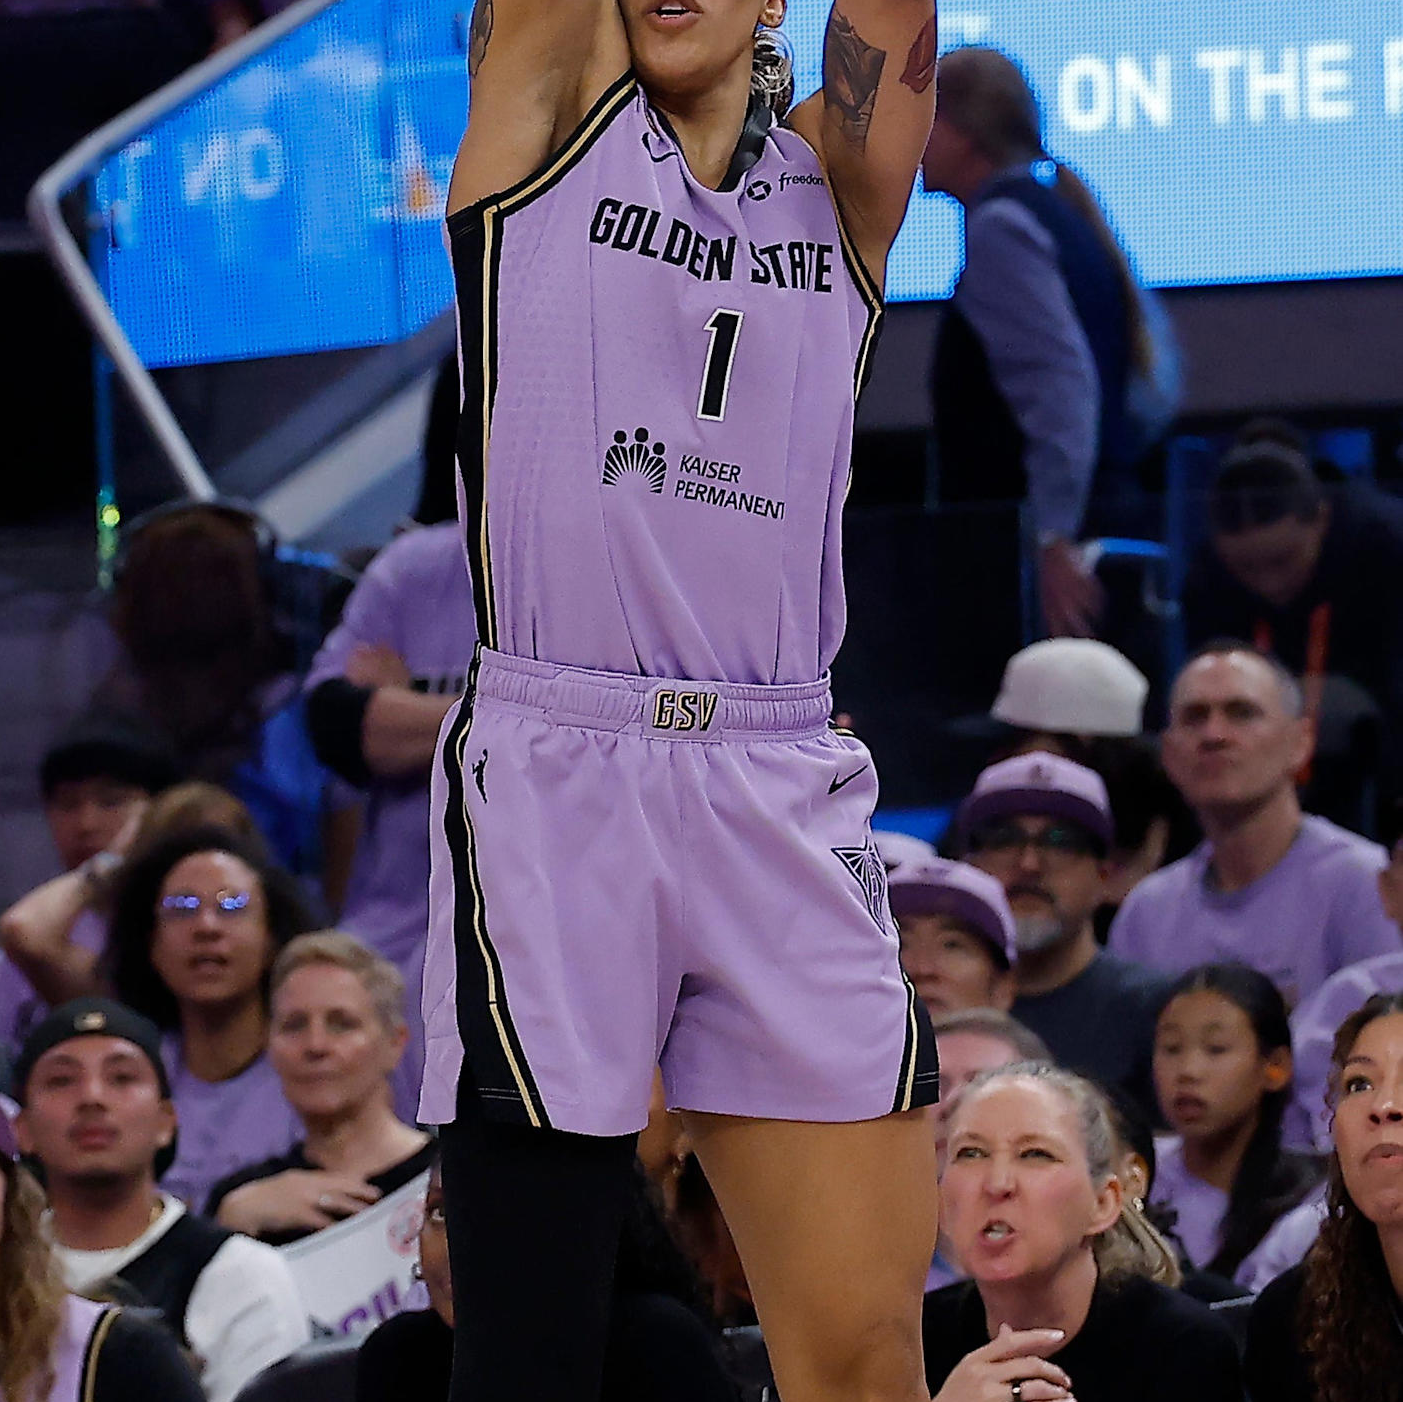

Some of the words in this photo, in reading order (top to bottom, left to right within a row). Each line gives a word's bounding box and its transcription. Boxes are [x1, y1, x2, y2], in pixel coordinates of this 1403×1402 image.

[1058, 51, 1172, 133] ON
[1195, 39, 1354, 125] THE
[589, 197, 737, 282] GOLDEN
[748, 241, 833, 293] STATE
[697, 307, 744, 423] 1
[679, 454, 741, 484] KAISER
[652, 689, 718, 732] GSV
